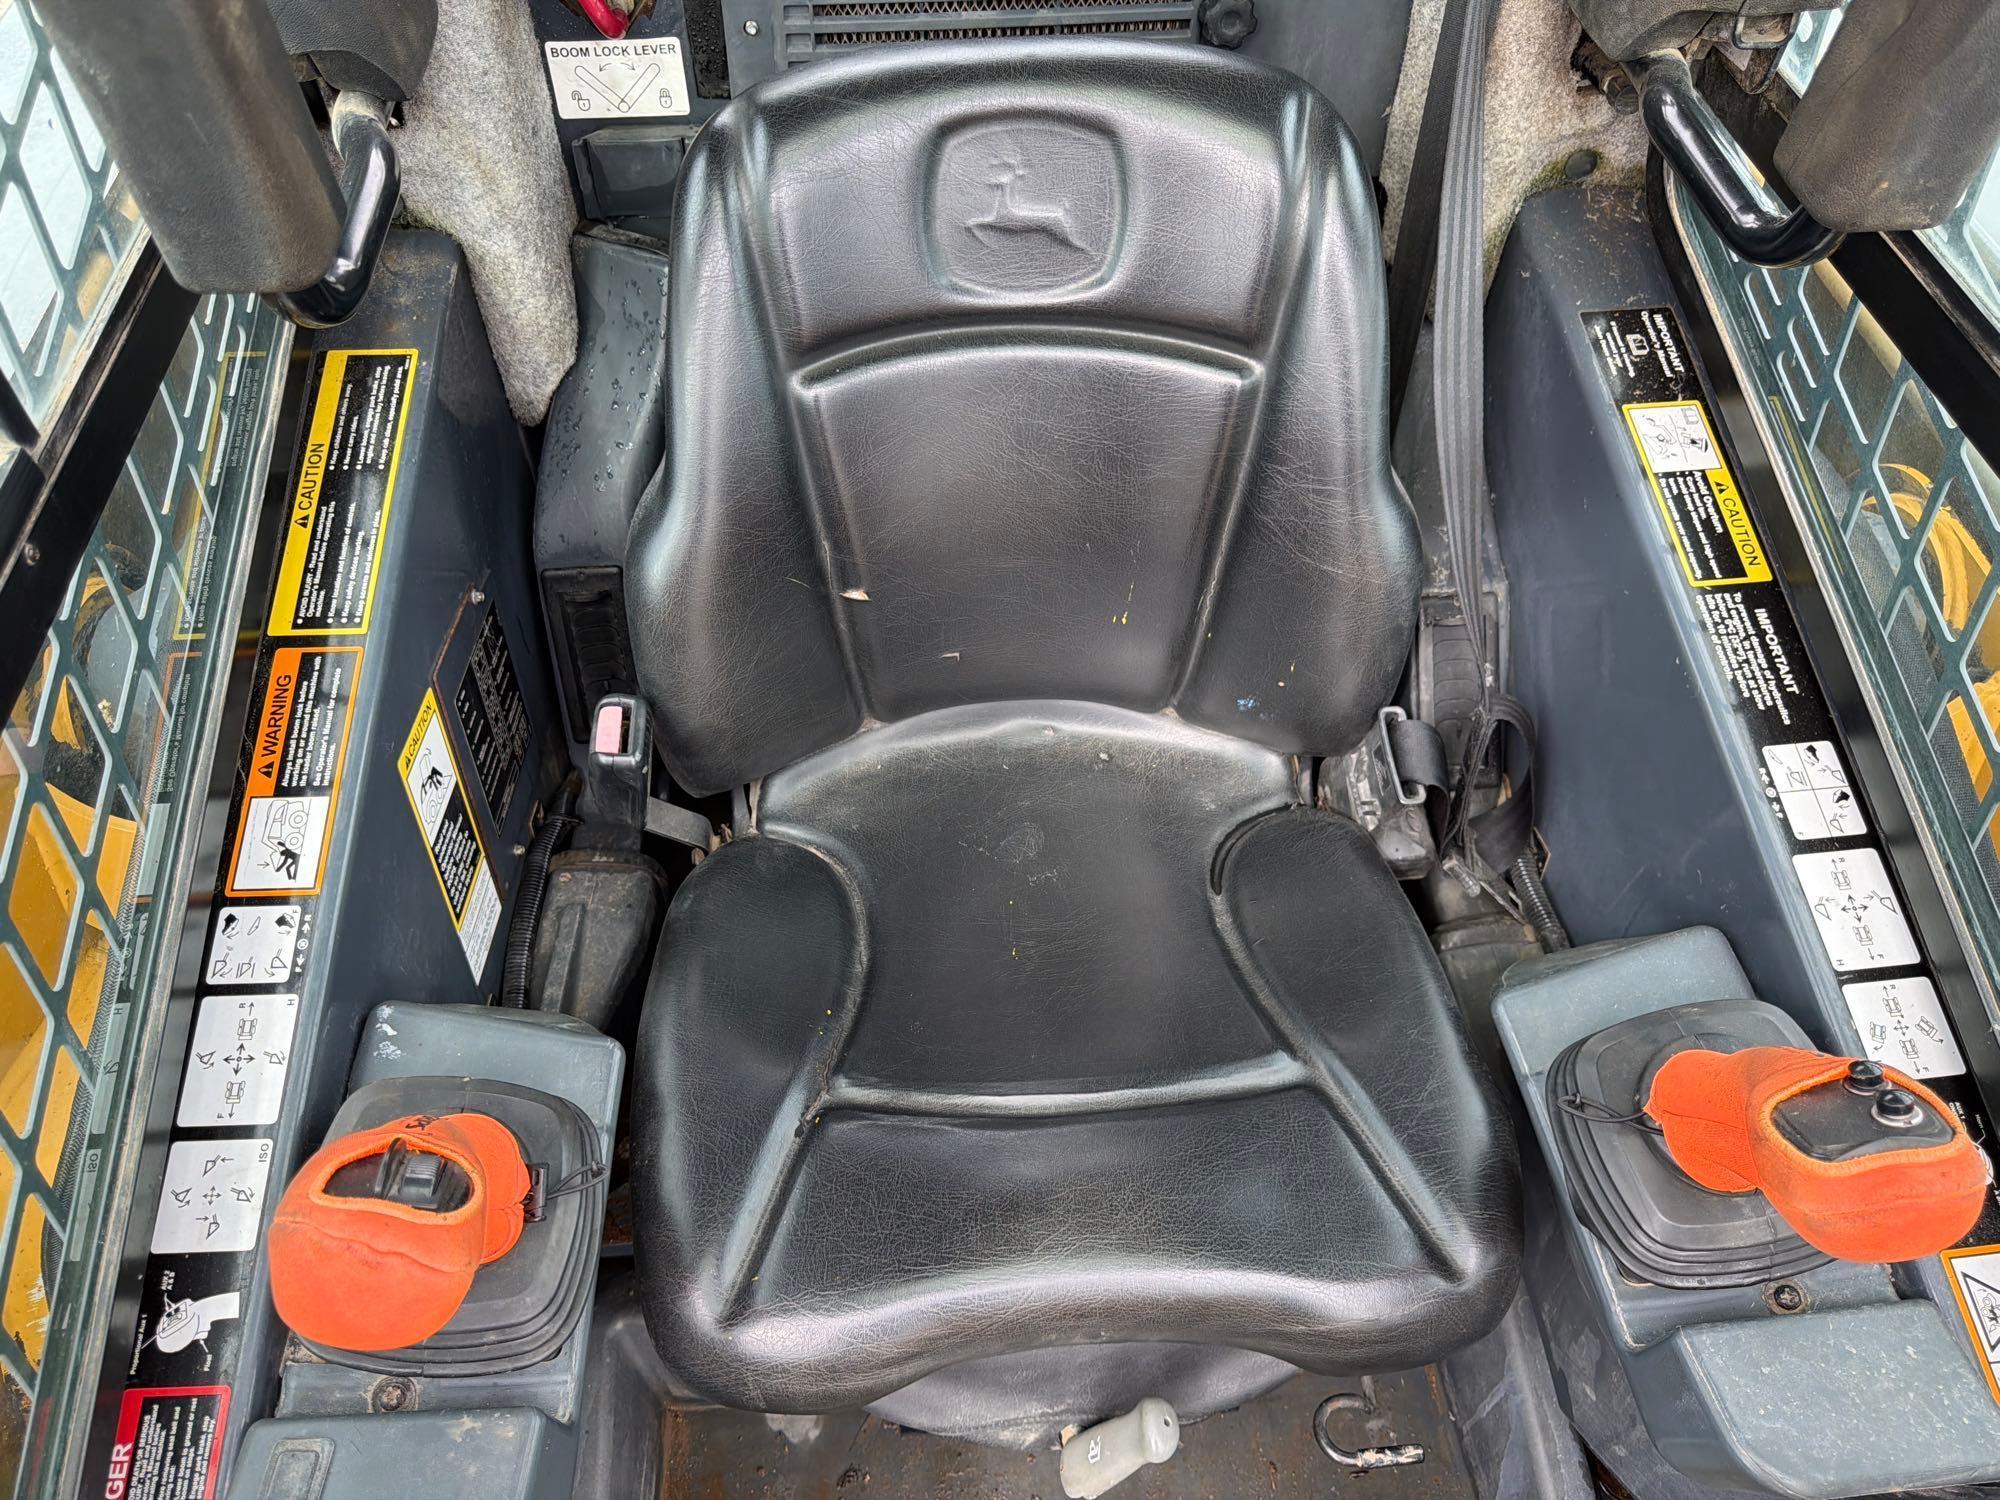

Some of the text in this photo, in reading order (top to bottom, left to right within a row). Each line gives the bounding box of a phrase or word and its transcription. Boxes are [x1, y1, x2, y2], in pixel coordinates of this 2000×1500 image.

[551, 44, 676, 58] BOOM LOCK LEVER
[1641, 311, 1674, 377] Operator's Manual
[1653, 314, 1684, 372] IMPORTANT
[298, 443, 324, 510] CAUTION
[1692, 471, 1722, 533] Avoid Overturn
[316, 506, 327, 539] understand
[346, 502, 356, 527] controls.
[1723, 498, 1760, 565] CAUTION
[307, 585, 318, 617] Operator's
[313, 562, 323, 584] Manual
[318, 541, 327, 561] before
[323, 513, 334, 541] operating
[308, 552, 317, 568] Read
[339, 535, 349, 560] function
[342, 530, 365, 616] Keep safety devices working.
[299, 597, 308, 617] AVOID
[303, 573, 313, 596] INJURY
[328, 598, 337, 616] Know
[332, 573, 342, 598] location
[1723, 593, 1735, 608] and
[1695, 595, 1715, 633] operation
[1714, 645, 1733, 682] controls.
[1725, 609, 1745, 639] engine,
[1711, 610, 1721, 623] for
[1721, 635, 1738, 668] minutes
[1734, 670, 1750, 697] before
[1714, 593, 1728, 618] below
[1741, 663, 1752, 678] run
[1752, 689, 1765, 710] slow
[1733, 592, 1790, 724] To prevent damage of hydraulics
[1755, 608, 1798, 693] IMPORTANT
[308, 671, 318, 699] machine
[1746, 650, 1772, 705] temperatures
[262, 675, 291, 756] WARNING
[301, 714, 310, 738] around
[305, 700, 313, 713] this
[313, 668, 341, 786] See Operator's Manual for complete
[408, 700, 431, 756] CAUTION
[281, 681, 308, 787] Always install boom lock before
[297, 748, 304, 757] on
[299, 707, 320, 786] the loader boom raised.
[292, 758, 303, 786] working
[322, 743, 336, 785] instructions.
[258, 1143, 269, 1162] ISO
[130, 1333, 143, 1374] Proportional
[131, 1461, 142, 1486] DEATH
[139, 1415, 150, 1447] SERIOUS
[139, 1459, 148, 1478] Read
[147, 1404, 158, 1443] understand
[146, 1423, 161, 1472] Manual before
[173, 1478, 182, 1500] Lower
[178, 1456, 186, 1477] boom
[184, 1421, 193, 1446] ground
[161, 1451, 173, 1484] removing
